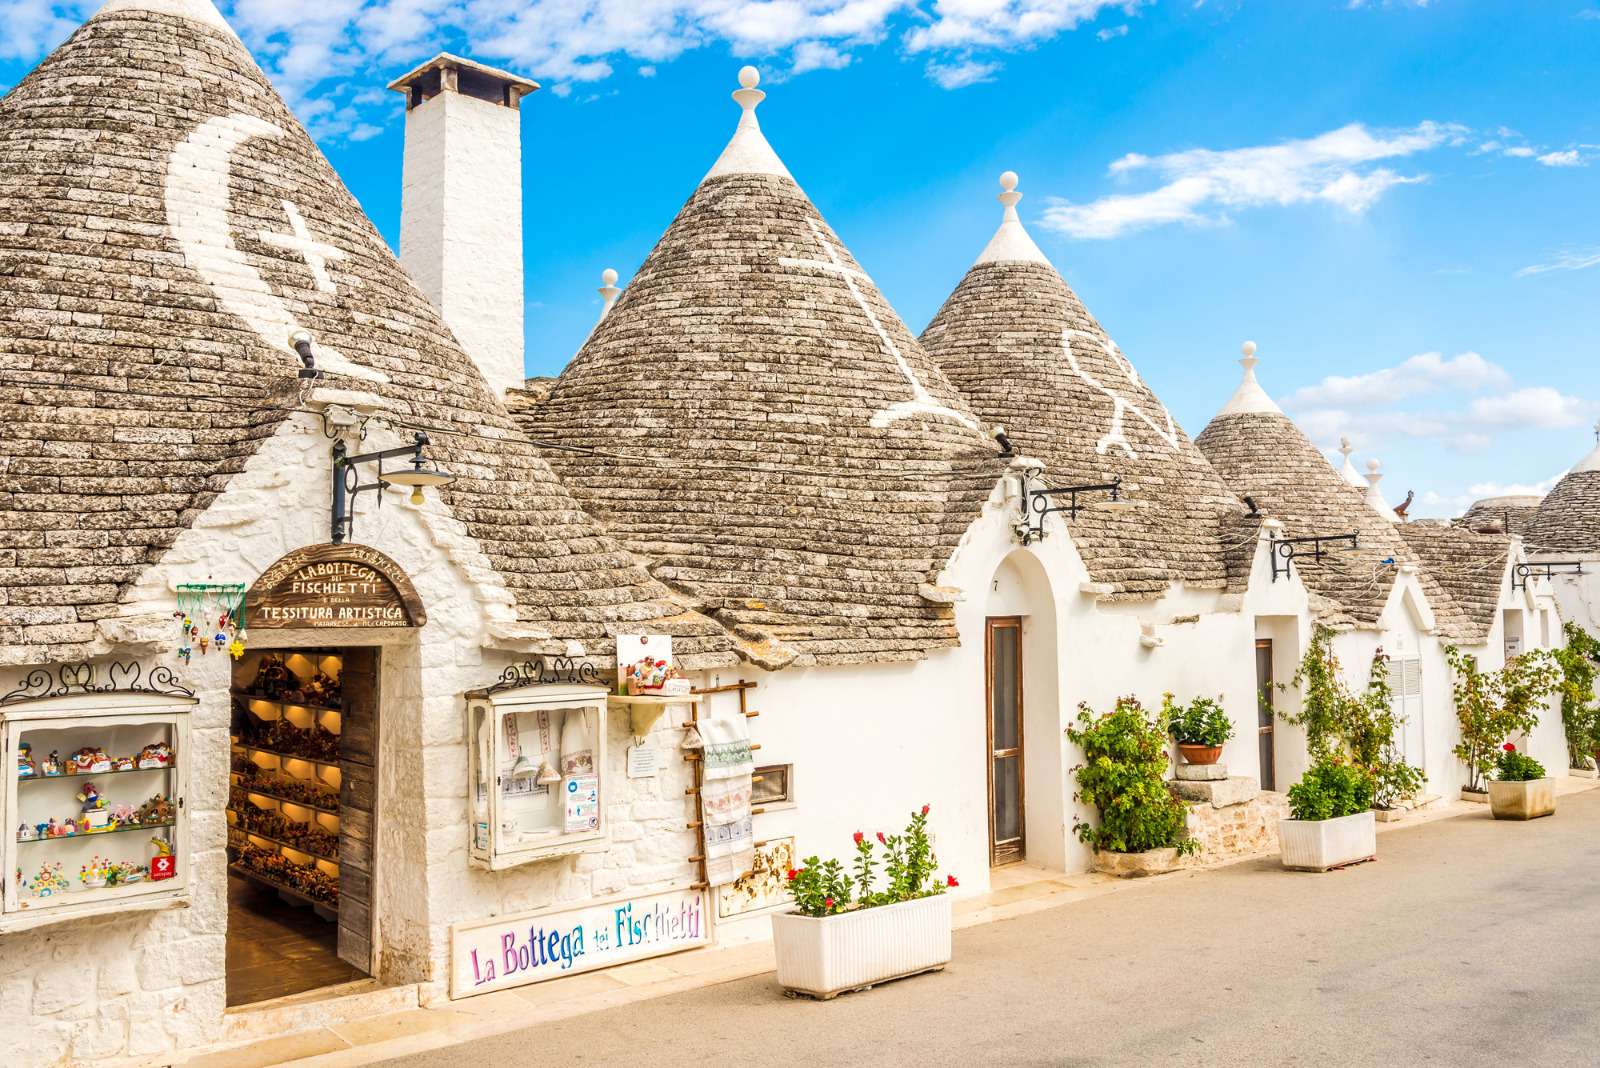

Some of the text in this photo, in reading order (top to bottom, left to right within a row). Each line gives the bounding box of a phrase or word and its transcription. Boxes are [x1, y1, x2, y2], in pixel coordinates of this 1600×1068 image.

[298, 562, 376, 583] LA BOTTEGA
[292, 582, 376, 594] FISCHIETTI
[993, 580, 999, 591] 7
[261, 607, 402, 619] TESSITURA ARTISTICA
[470, 947, 496, 986] La
[500, 924, 585, 976] Bottega
[614, 895, 700, 948] Fischietti
